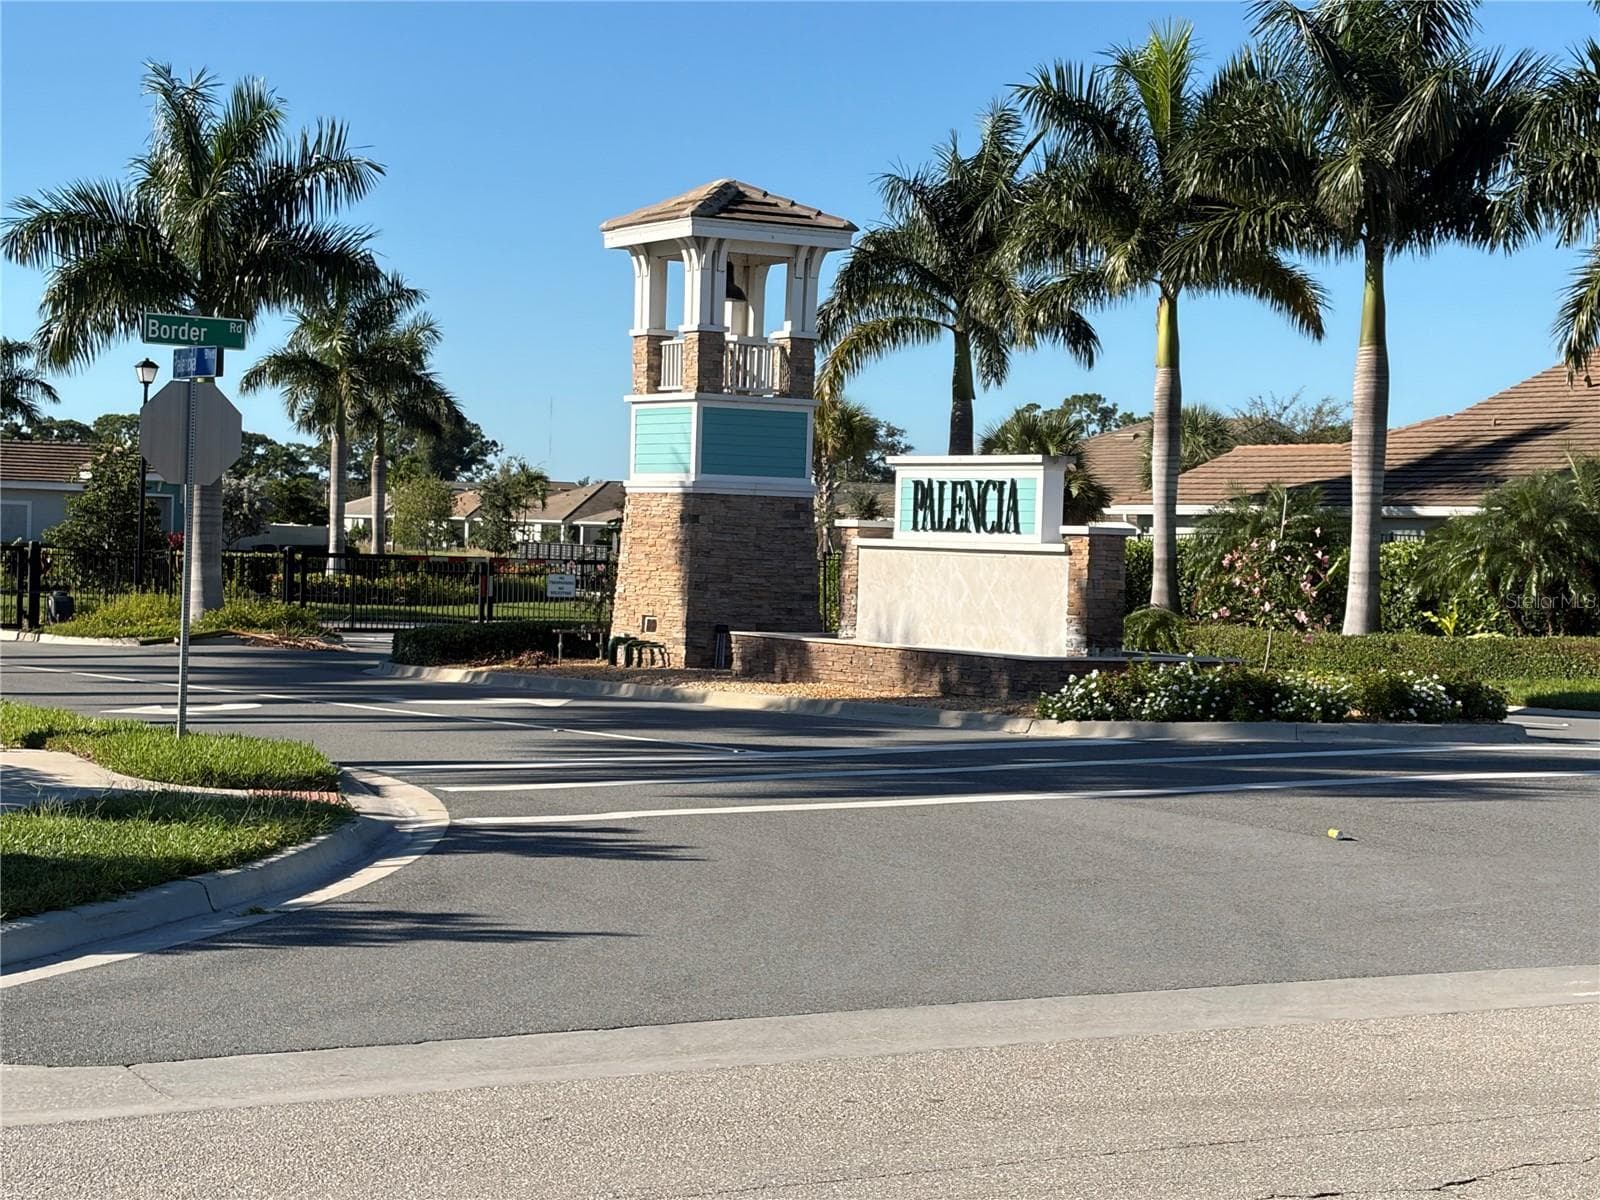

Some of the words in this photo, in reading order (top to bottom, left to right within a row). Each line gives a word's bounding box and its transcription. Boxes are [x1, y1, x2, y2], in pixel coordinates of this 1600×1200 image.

[148, 319, 208, 341] Border
[229, 322, 243, 333] Rd
[911, 478, 1022, 535] PALENCIA
